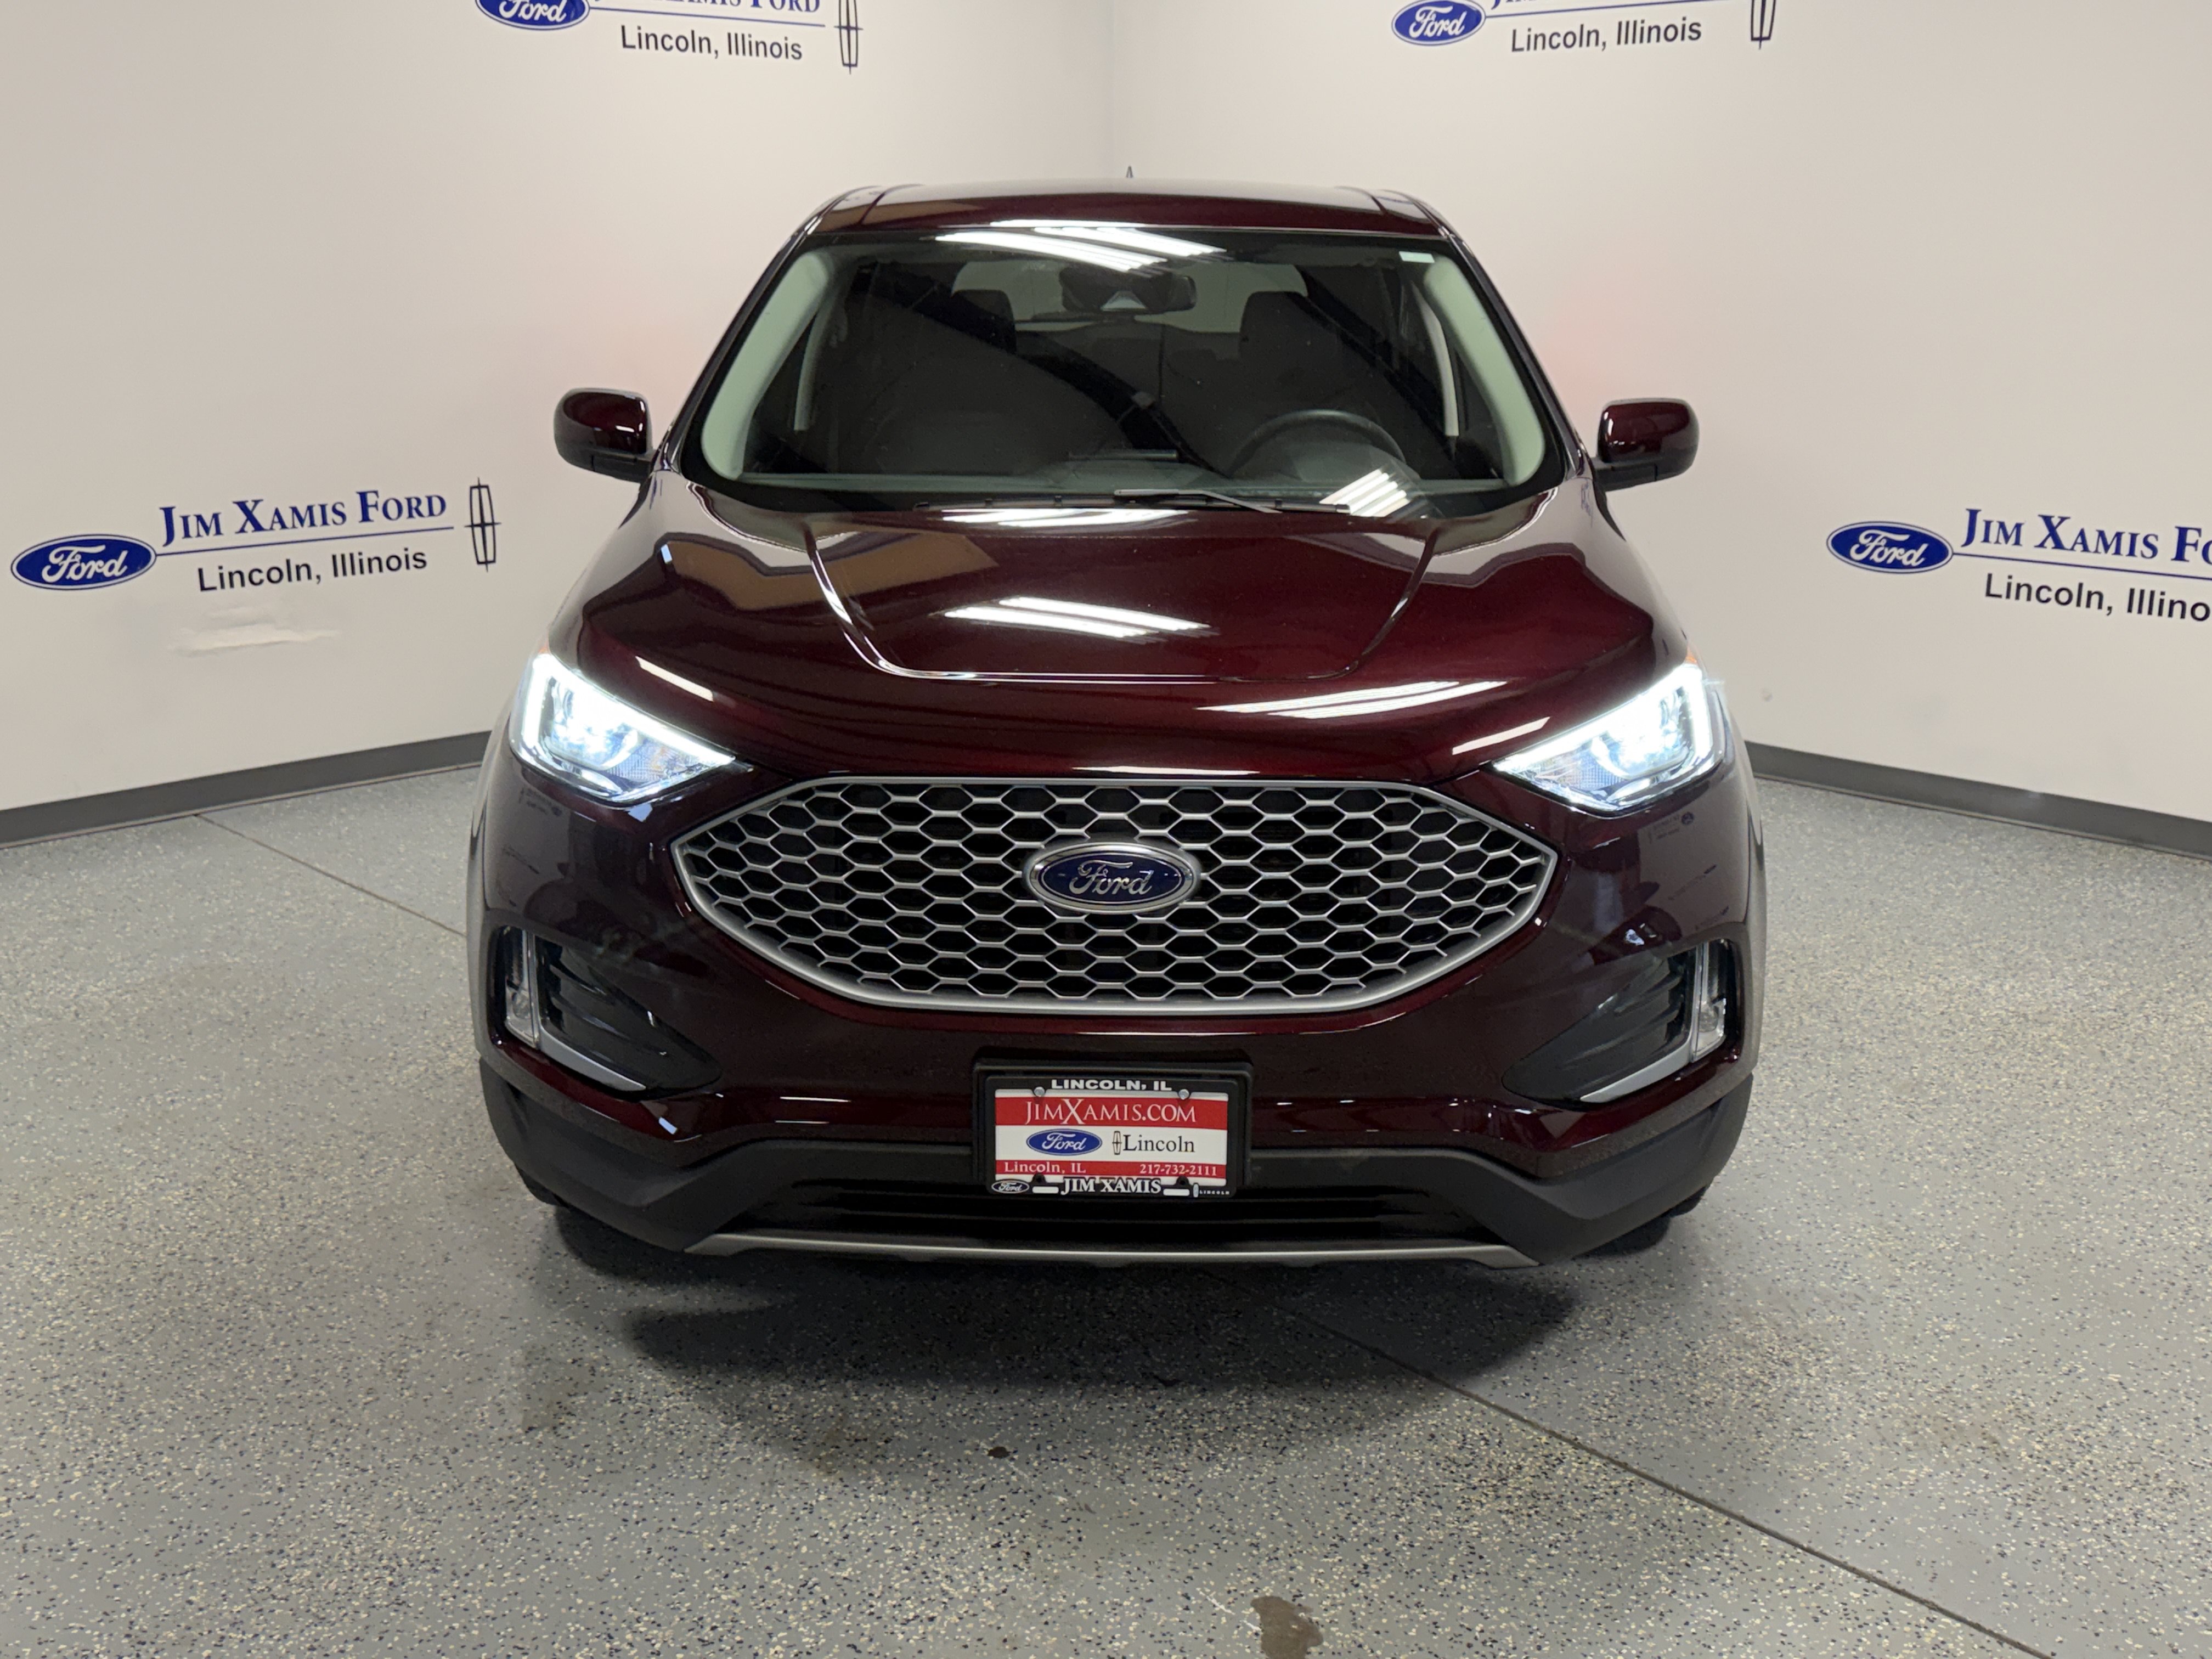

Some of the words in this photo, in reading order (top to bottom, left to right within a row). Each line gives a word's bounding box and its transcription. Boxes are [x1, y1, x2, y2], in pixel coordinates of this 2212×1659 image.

[1408, 7, 1465, 38] Ford
[1511, 24, 1607, 52] Lincoln,
[1616, 16, 1702, 45] Illinois
[620, 25, 719, 58] Lincoln,
[727, 32, 803, 60] Illinois
[159, 505, 223, 548] JIM
[234, 498, 347, 534] XAMIS
[356, 489, 447, 524] FORD
[1960, 508, 2026, 549] JIM
[2034, 514, 2159, 560] XAMIS
[41, 544, 128, 583] Ford
[1850, 528, 1927, 567] Ford
[197, 557, 322, 592] Lincoln,
[331, 547, 427, 578] Illinois
[1984, 573, 2114, 616] Lincoln,
[1069, 859, 1155, 895] Ford
[1051, 1079, 1147, 1091] LINCOLN,
[1153, 1081, 1172, 1091] IL
[1025, 1098, 1197, 1125] JIMXAMIS.COM
[1042, 1132, 1087, 1152] Ford
[1122, 1134, 1195, 1153] Lincoln
[1004, 1161, 1066, 1174] Lincoln,
[1071, 1163, 1086, 1173] IL
[1139, 1164, 1217, 1176] 217-732-2111
[998, 1182, 1023, 1192] Ford
[1060, 1178, 1096, 1195] JIM
[1100, 1178, 1162, 1194] XAMIS
